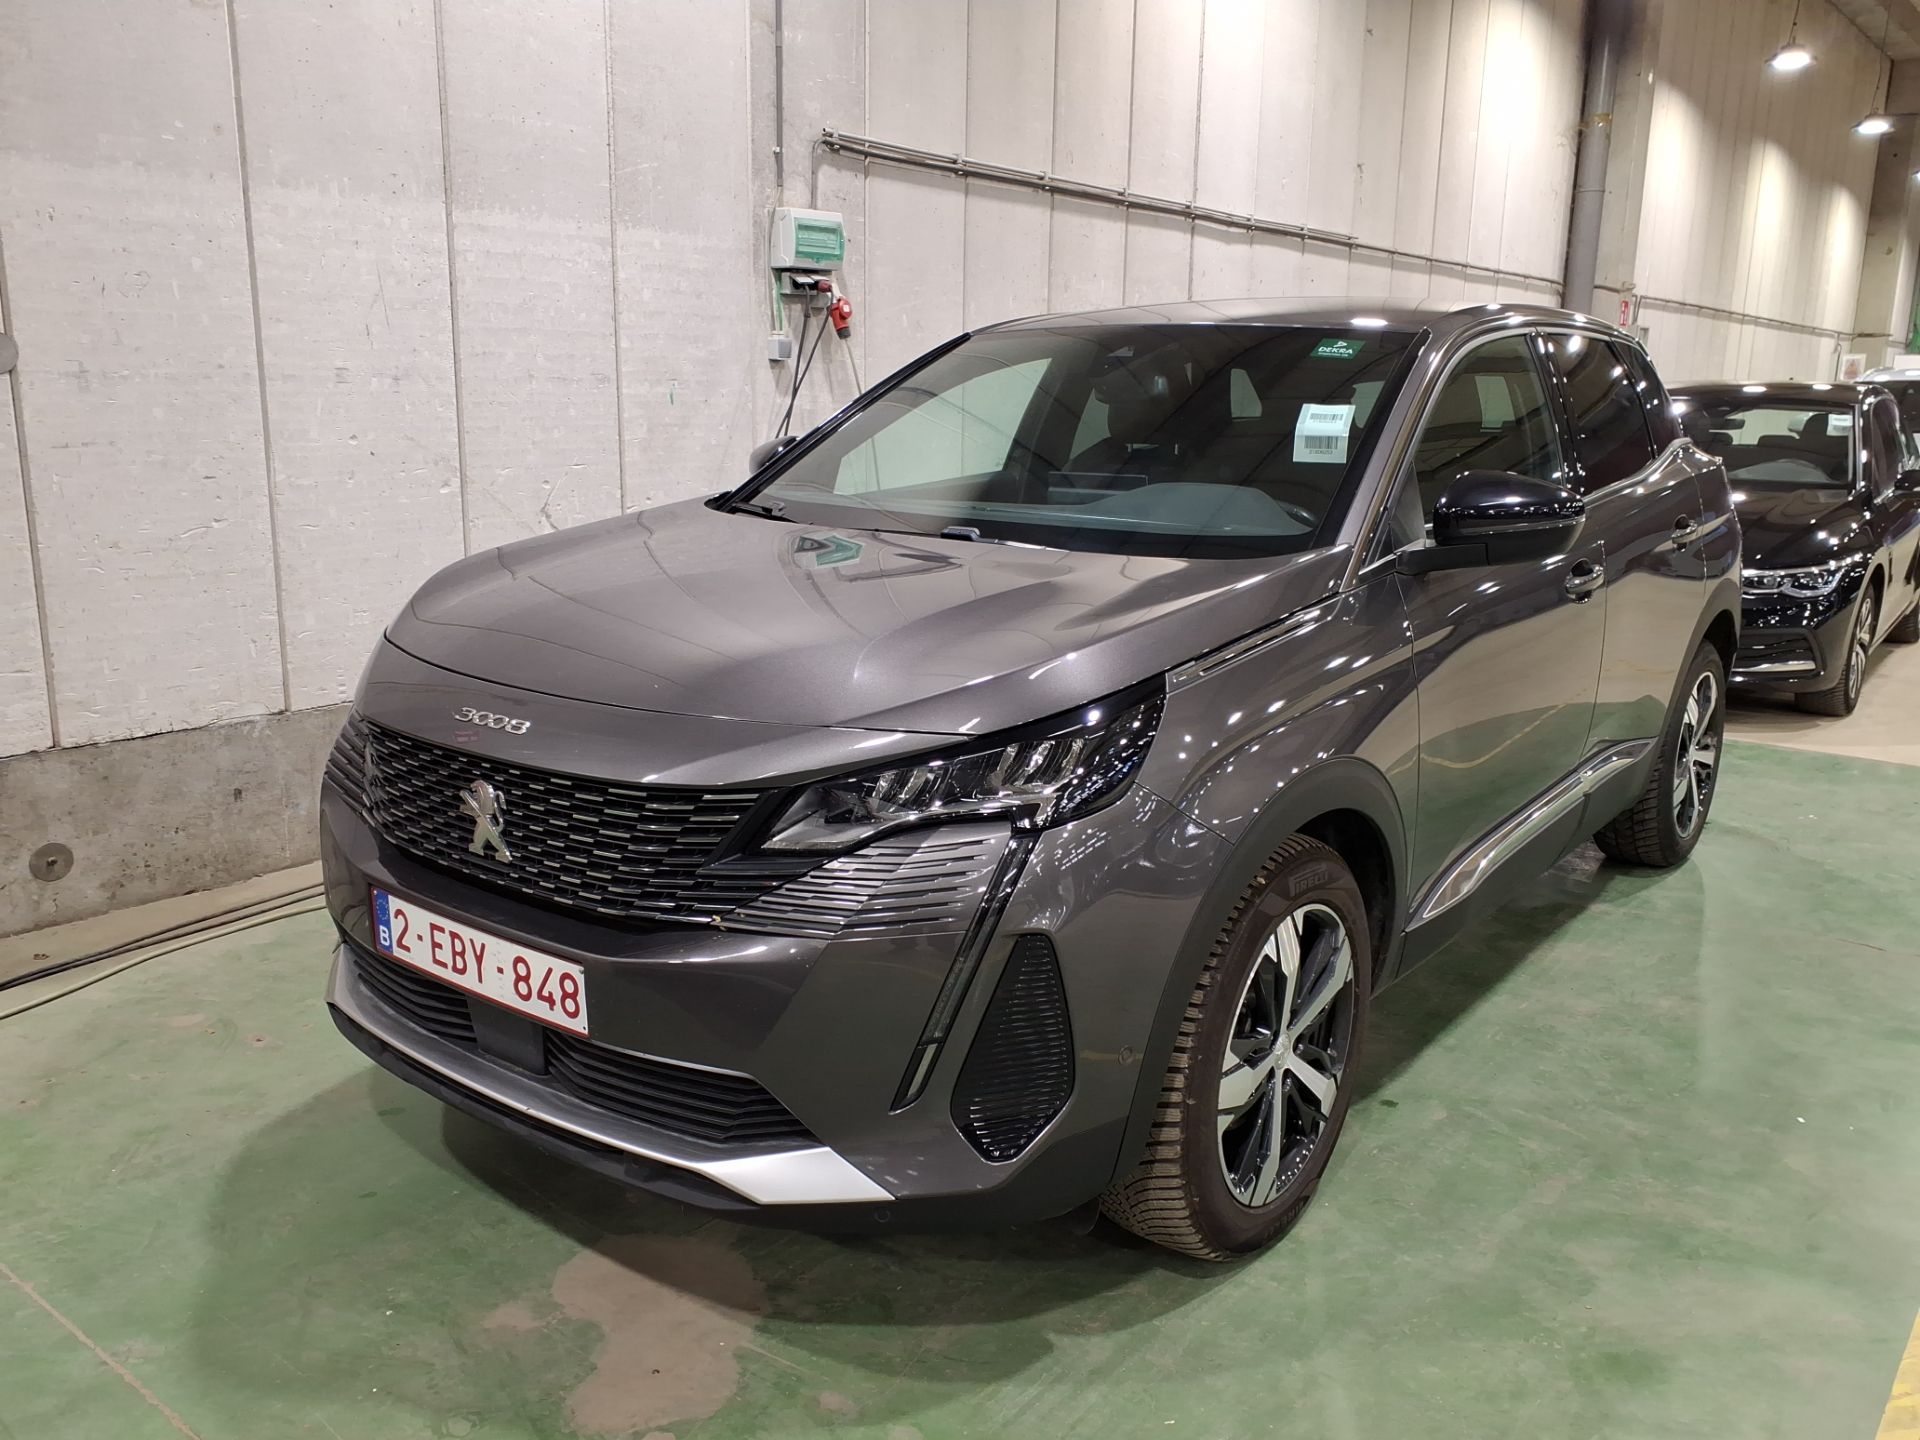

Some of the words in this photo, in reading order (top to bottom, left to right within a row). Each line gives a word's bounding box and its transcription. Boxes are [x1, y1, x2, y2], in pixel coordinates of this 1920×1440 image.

[1318, 346, 1353, 354] DEKRA
[454, 706, 531, 735] 3008
[379, 925, 391, 947] B
[393, 908, 581, 1020] 2-EBY-848
